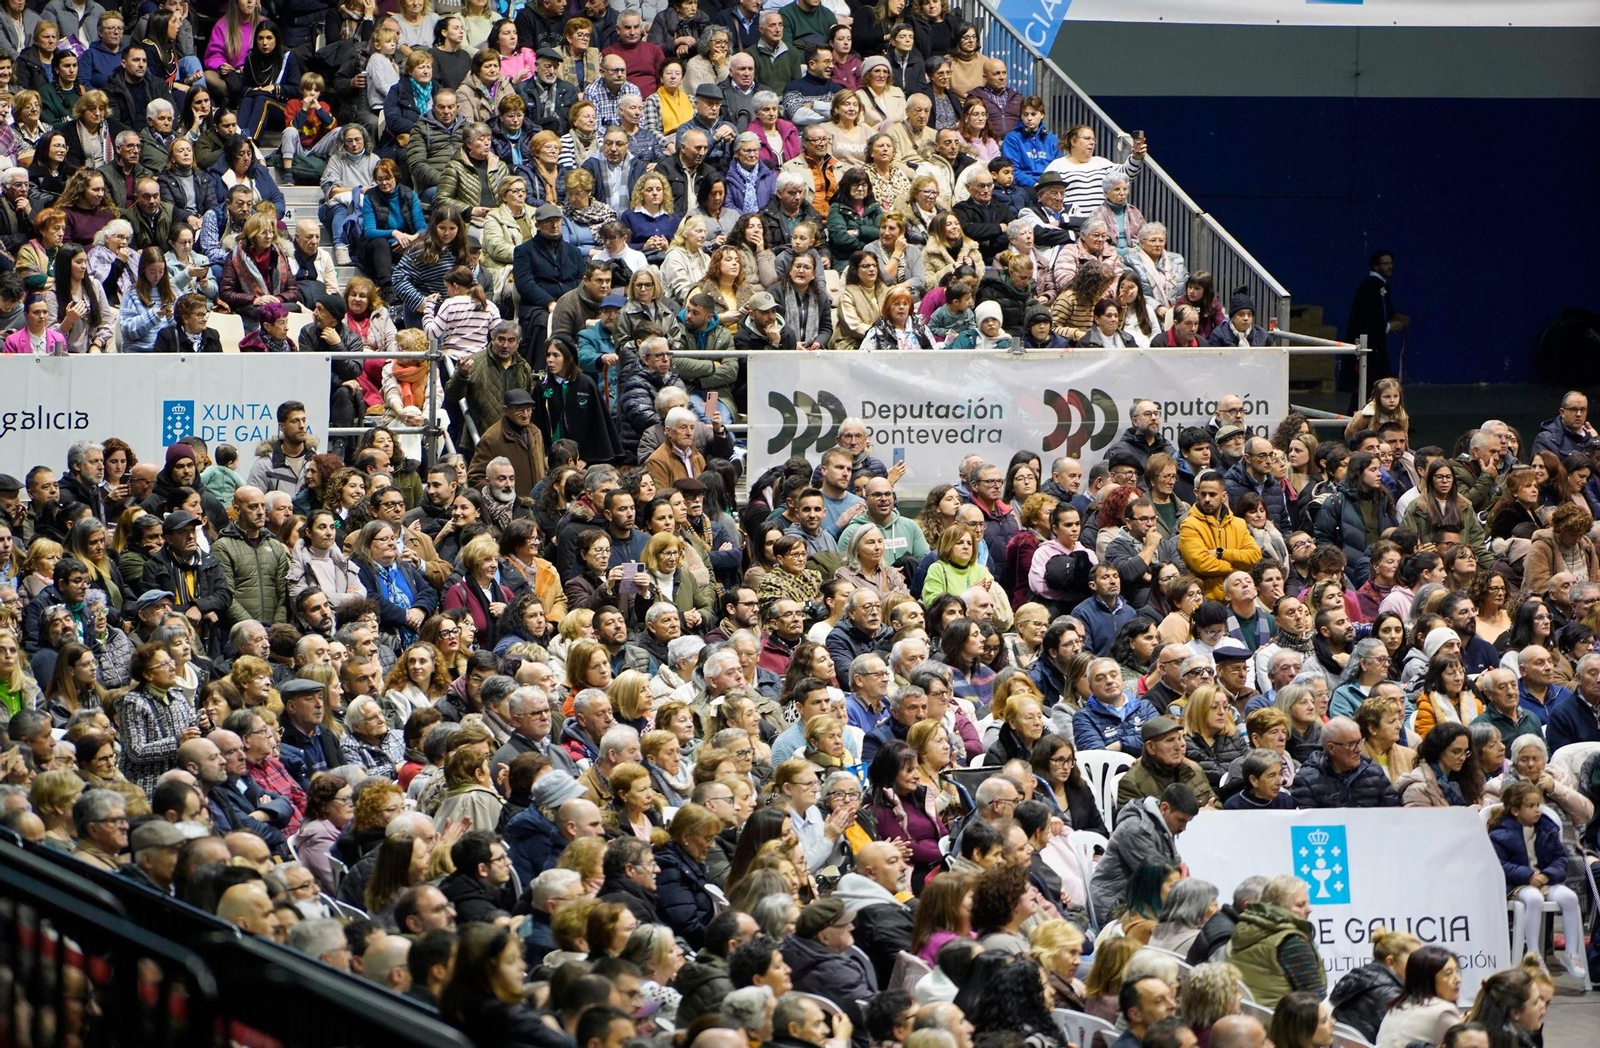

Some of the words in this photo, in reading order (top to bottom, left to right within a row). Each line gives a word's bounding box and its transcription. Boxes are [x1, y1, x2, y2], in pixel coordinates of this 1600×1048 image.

[202, 404, 274, 420] XUNTA
[861, 398, 1003, 426] Deputación
[1133, 393, 1269, 422] putaón
[0, 405, 89, 438] galicia
[202, 425, 227, 442] DE
[234, 425, 313, 442] GALI
[1322, 956, 1373, 972] ULTU
[1457, 950, 1497, 970] CIÓN
